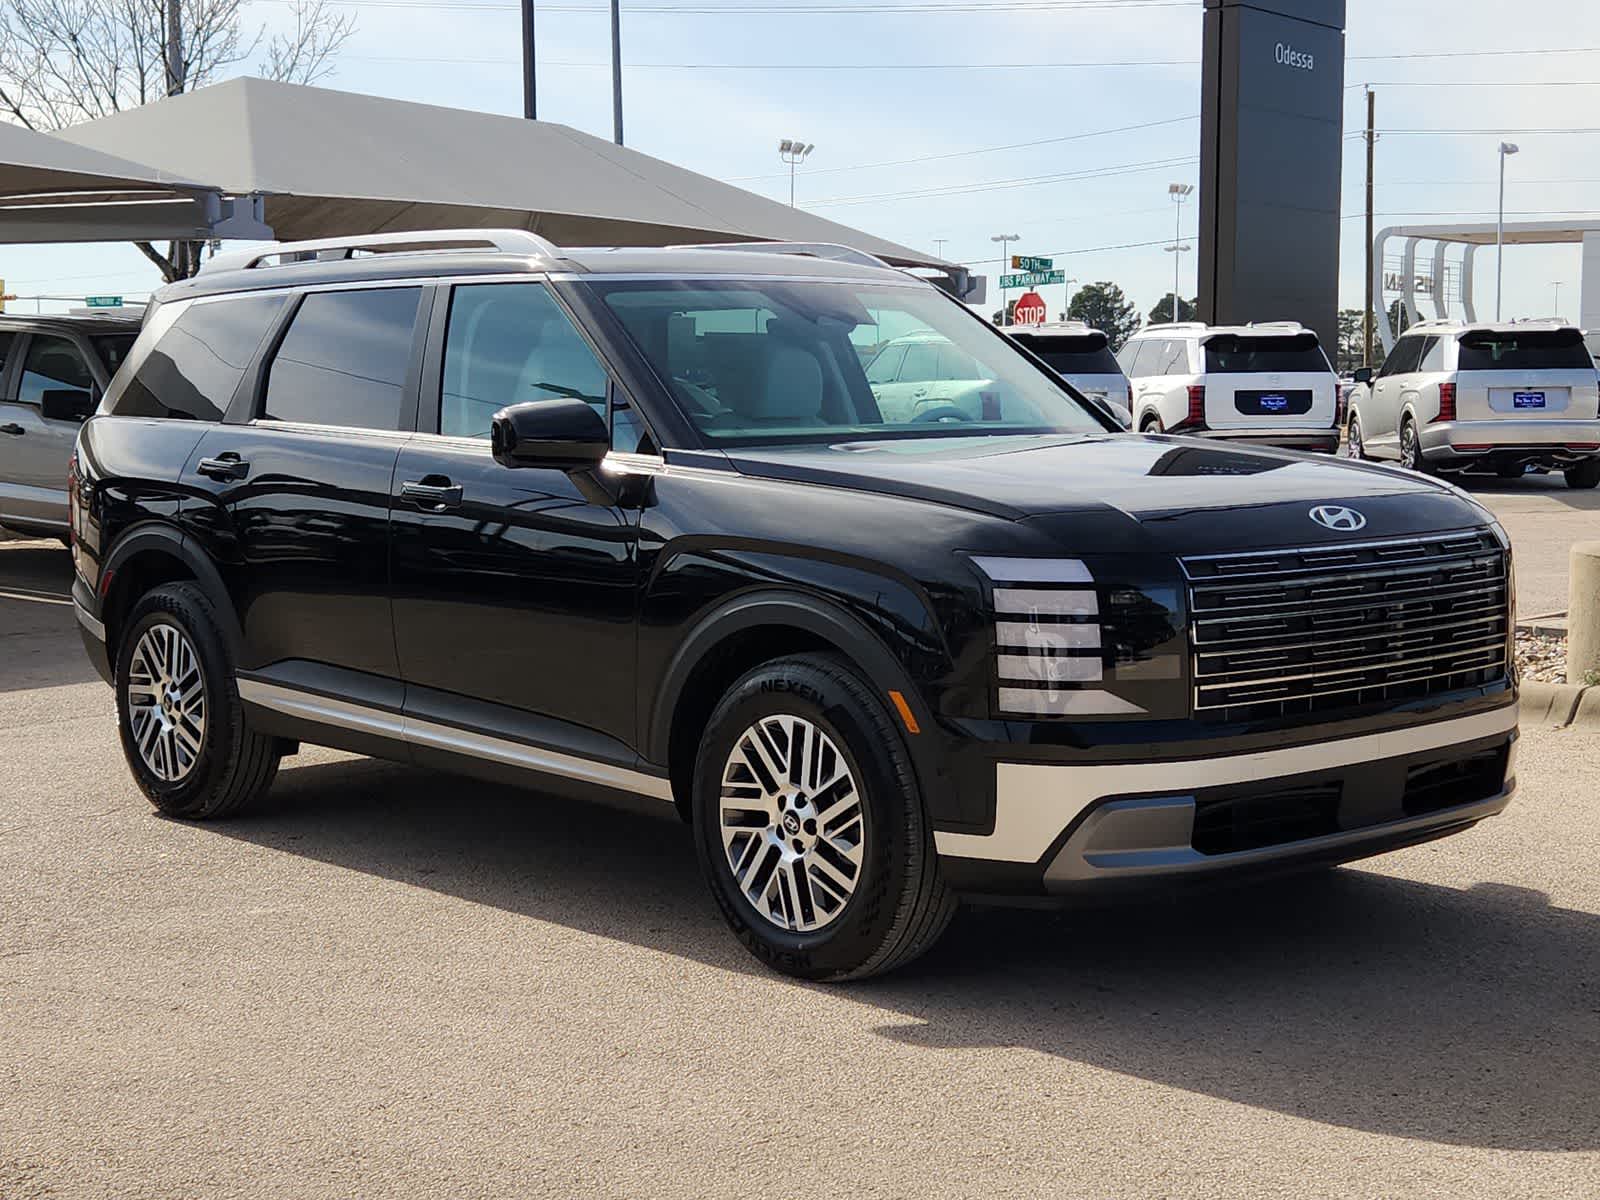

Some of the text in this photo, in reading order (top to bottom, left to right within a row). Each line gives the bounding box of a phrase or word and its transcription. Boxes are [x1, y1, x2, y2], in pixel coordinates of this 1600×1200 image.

[1275, 43, 1313, 69] Odessa
[1016, 272, 1050, 285] PARKWAY
[1016, 306, 1044, 324] STOP
[760, 678, 825, 705] NEXEN
